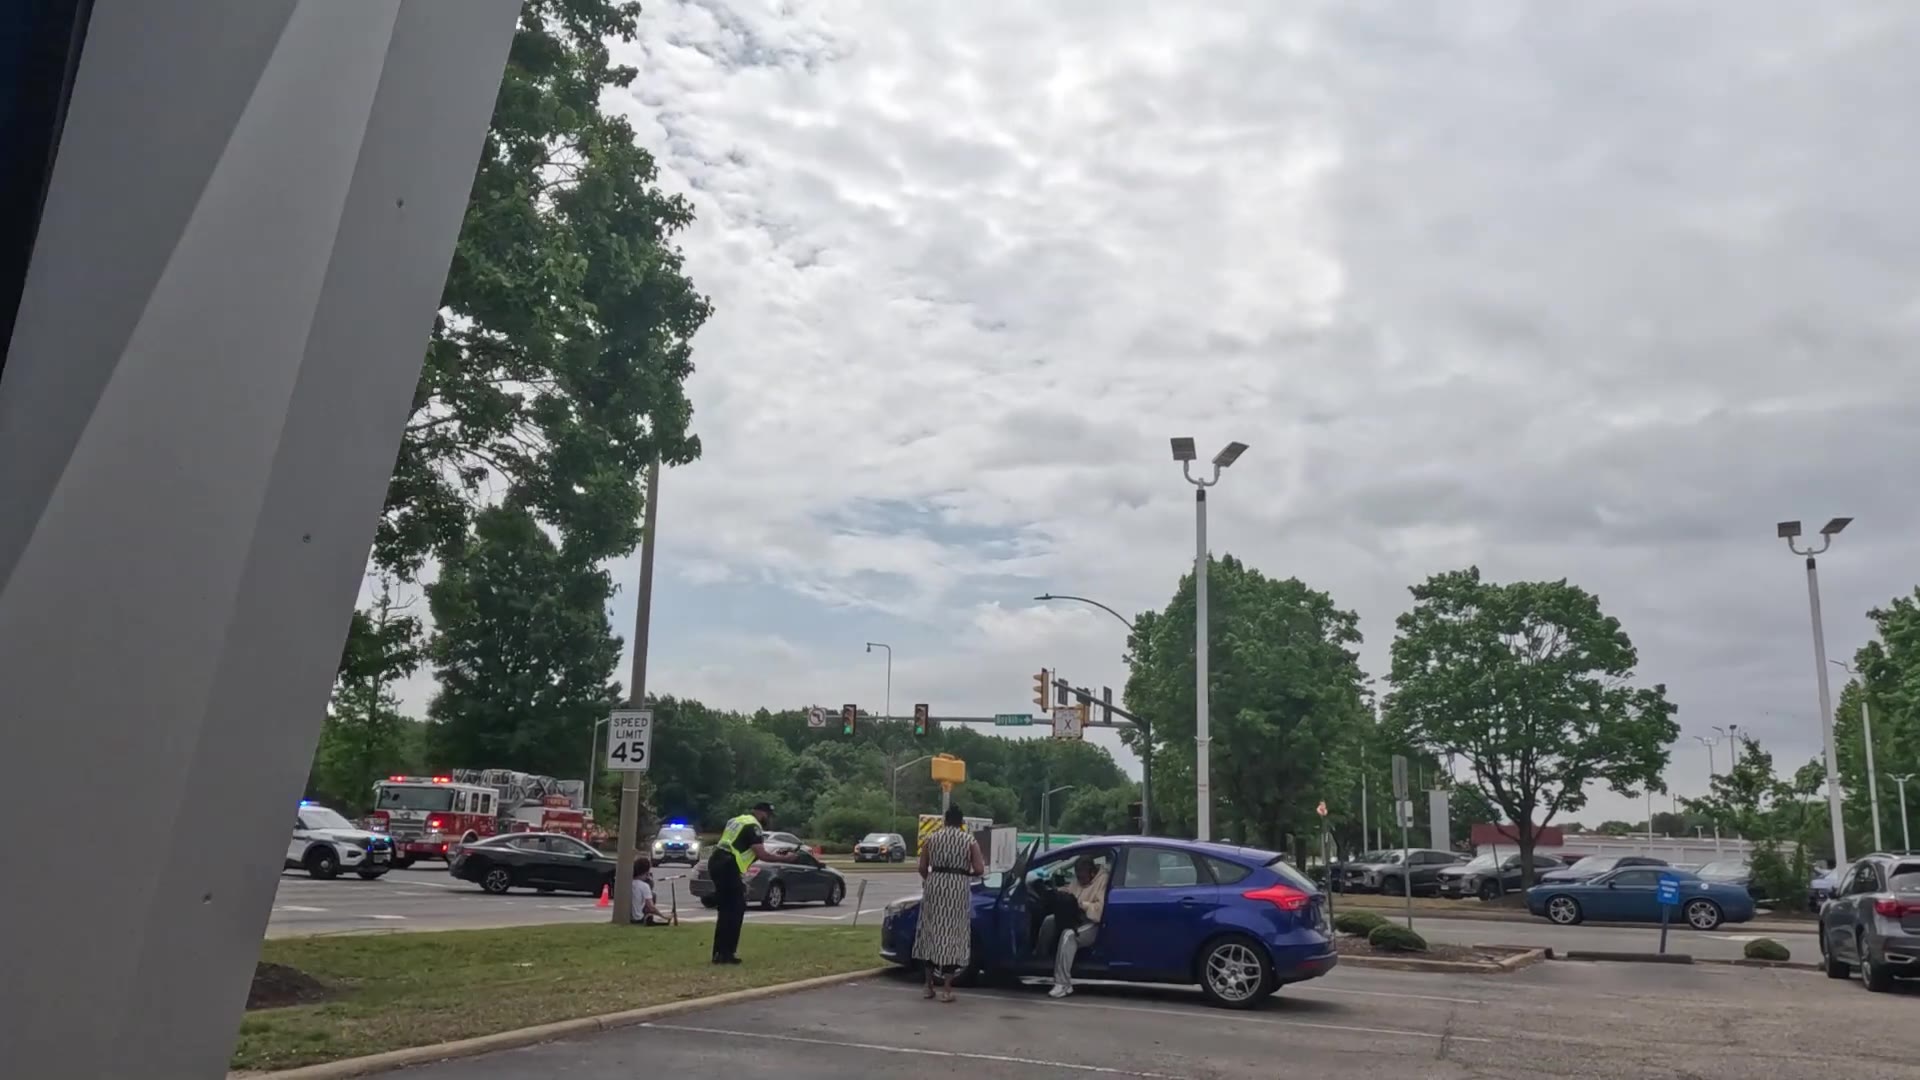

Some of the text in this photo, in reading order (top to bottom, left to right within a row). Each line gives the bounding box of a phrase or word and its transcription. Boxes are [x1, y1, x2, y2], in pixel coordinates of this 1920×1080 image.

[613, 717, 648, 727] SPEED
[616, 729, 643, 739] LIMIT
[611, 741, 645, 763] 45
